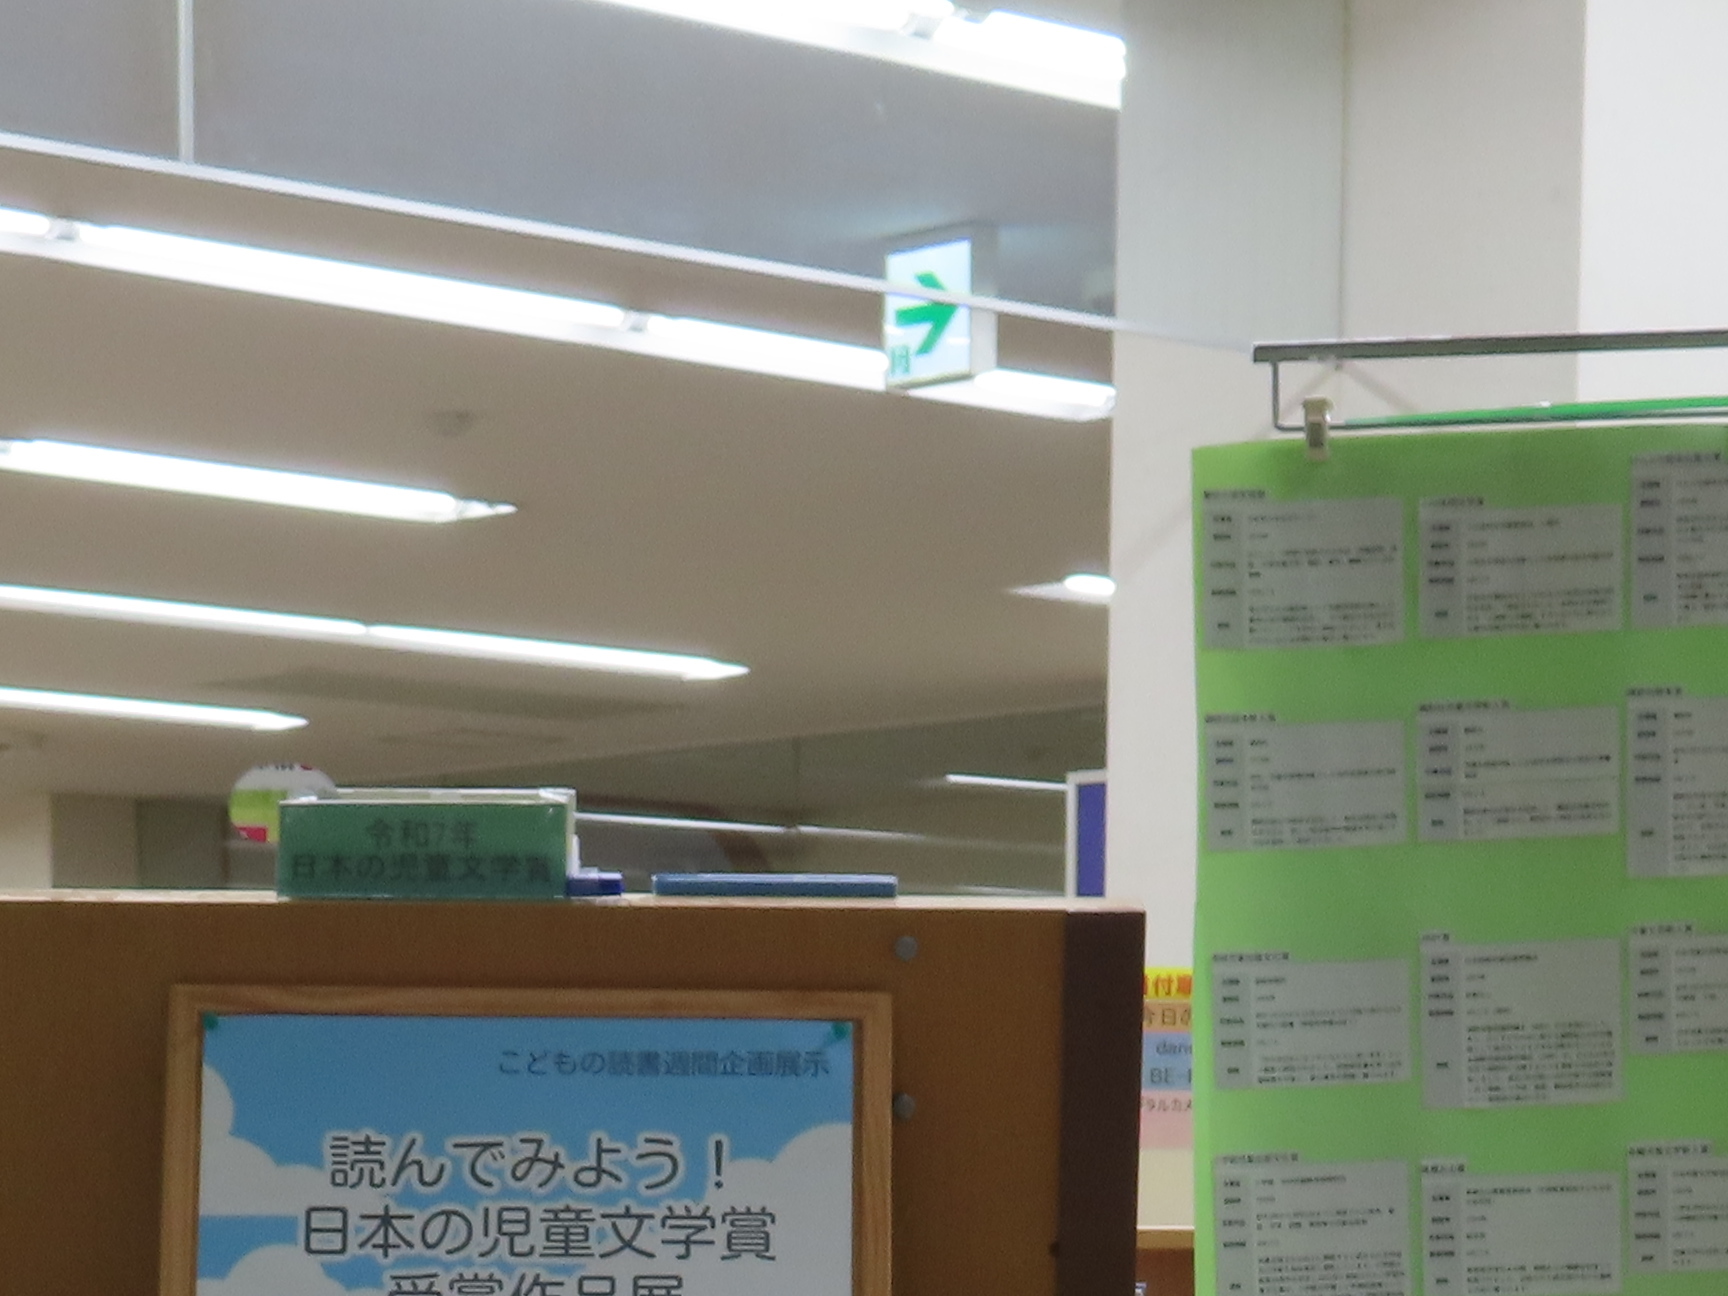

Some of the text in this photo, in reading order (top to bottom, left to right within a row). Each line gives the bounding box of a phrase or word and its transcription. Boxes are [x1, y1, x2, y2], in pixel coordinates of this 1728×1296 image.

[497, 1048, 830, 1079] こどもの読書週間企画展示
[1149, 1066, 1192, 1085] BE-
[301, 1203, 778, 1262] 日本の児童文学賞
